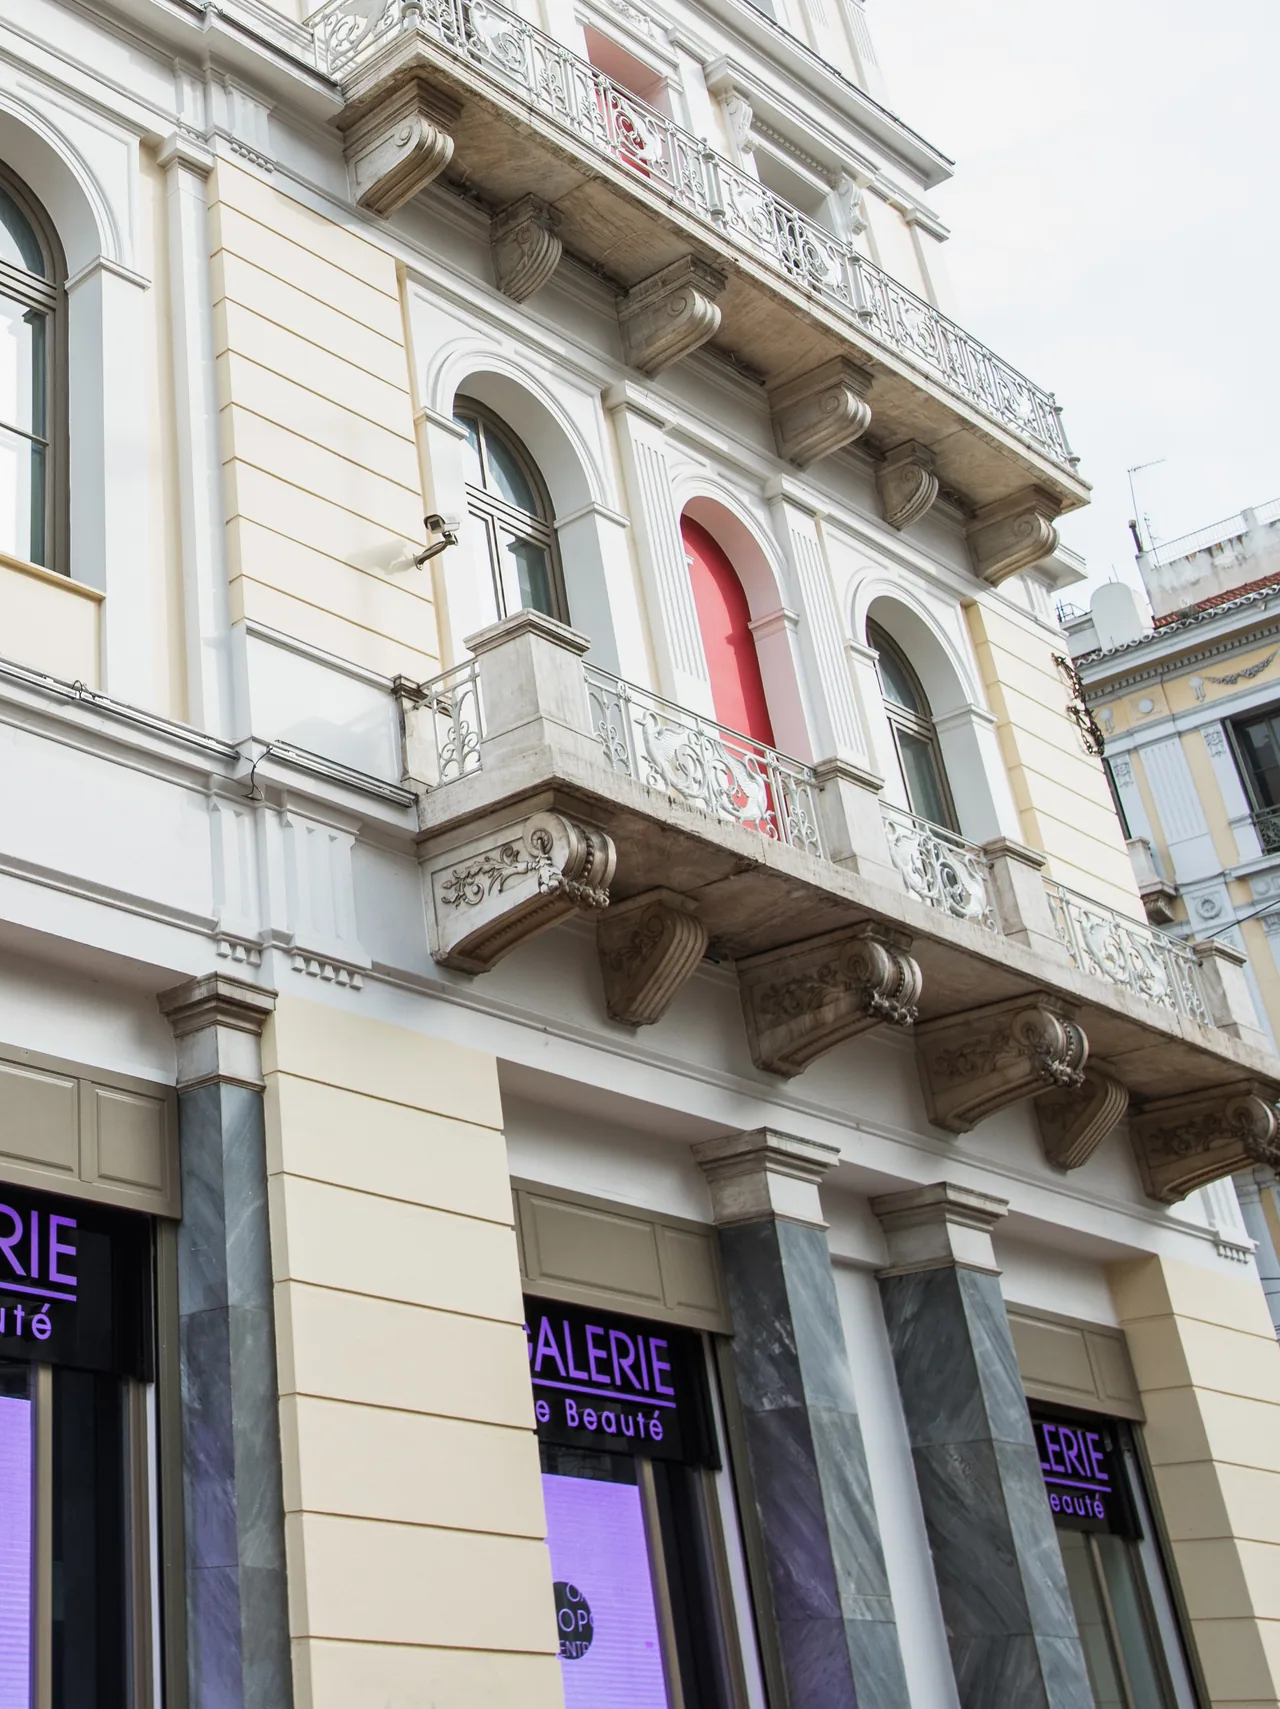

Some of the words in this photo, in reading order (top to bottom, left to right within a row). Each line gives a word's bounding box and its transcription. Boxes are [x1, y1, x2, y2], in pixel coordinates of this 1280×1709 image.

[523, 1315, 675, 1396] ALERIE
[564, 1398, 663, 1441] Beauté
[1039, 1423, 1109, 1481] ERIE
